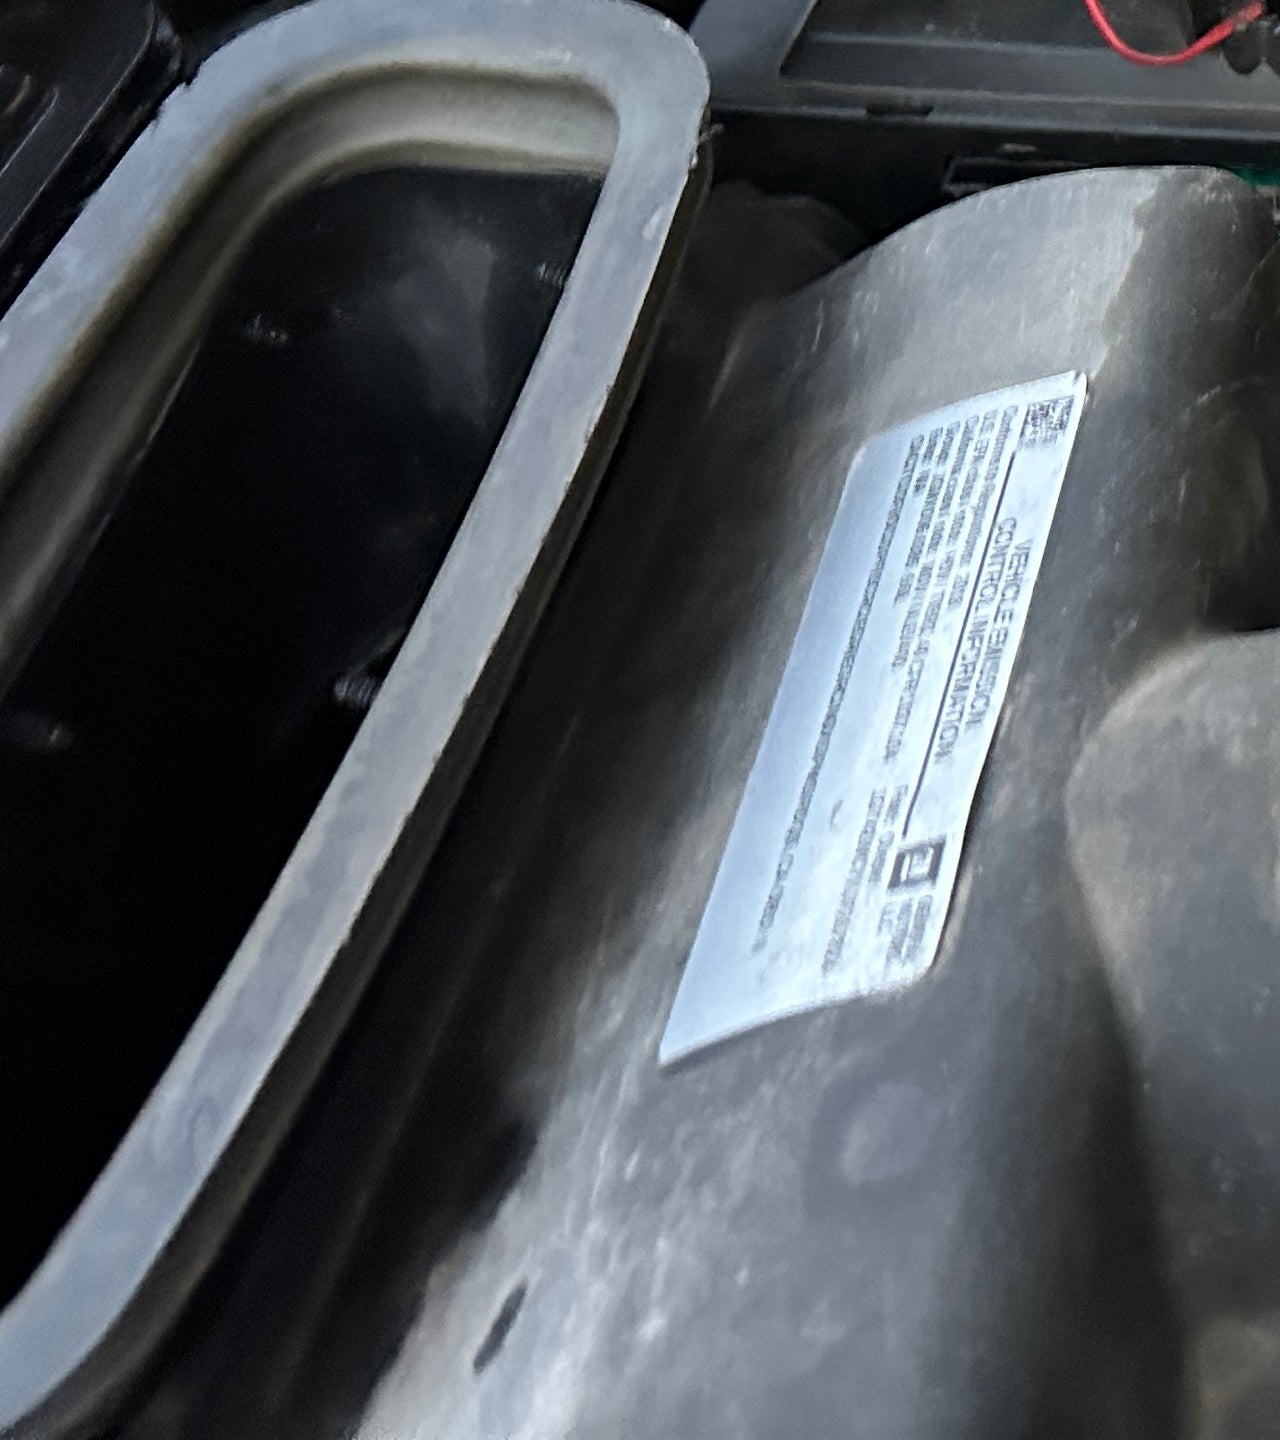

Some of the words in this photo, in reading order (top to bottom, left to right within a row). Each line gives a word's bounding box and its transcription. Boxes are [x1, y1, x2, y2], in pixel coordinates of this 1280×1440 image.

[976, 517, 1018, 610] CONTROL
[995, 538, 1032, 623] VEHICLE
[933, 615, 990, 762] INFORMATION
[965, 625, 1010, 727] EMISSION
